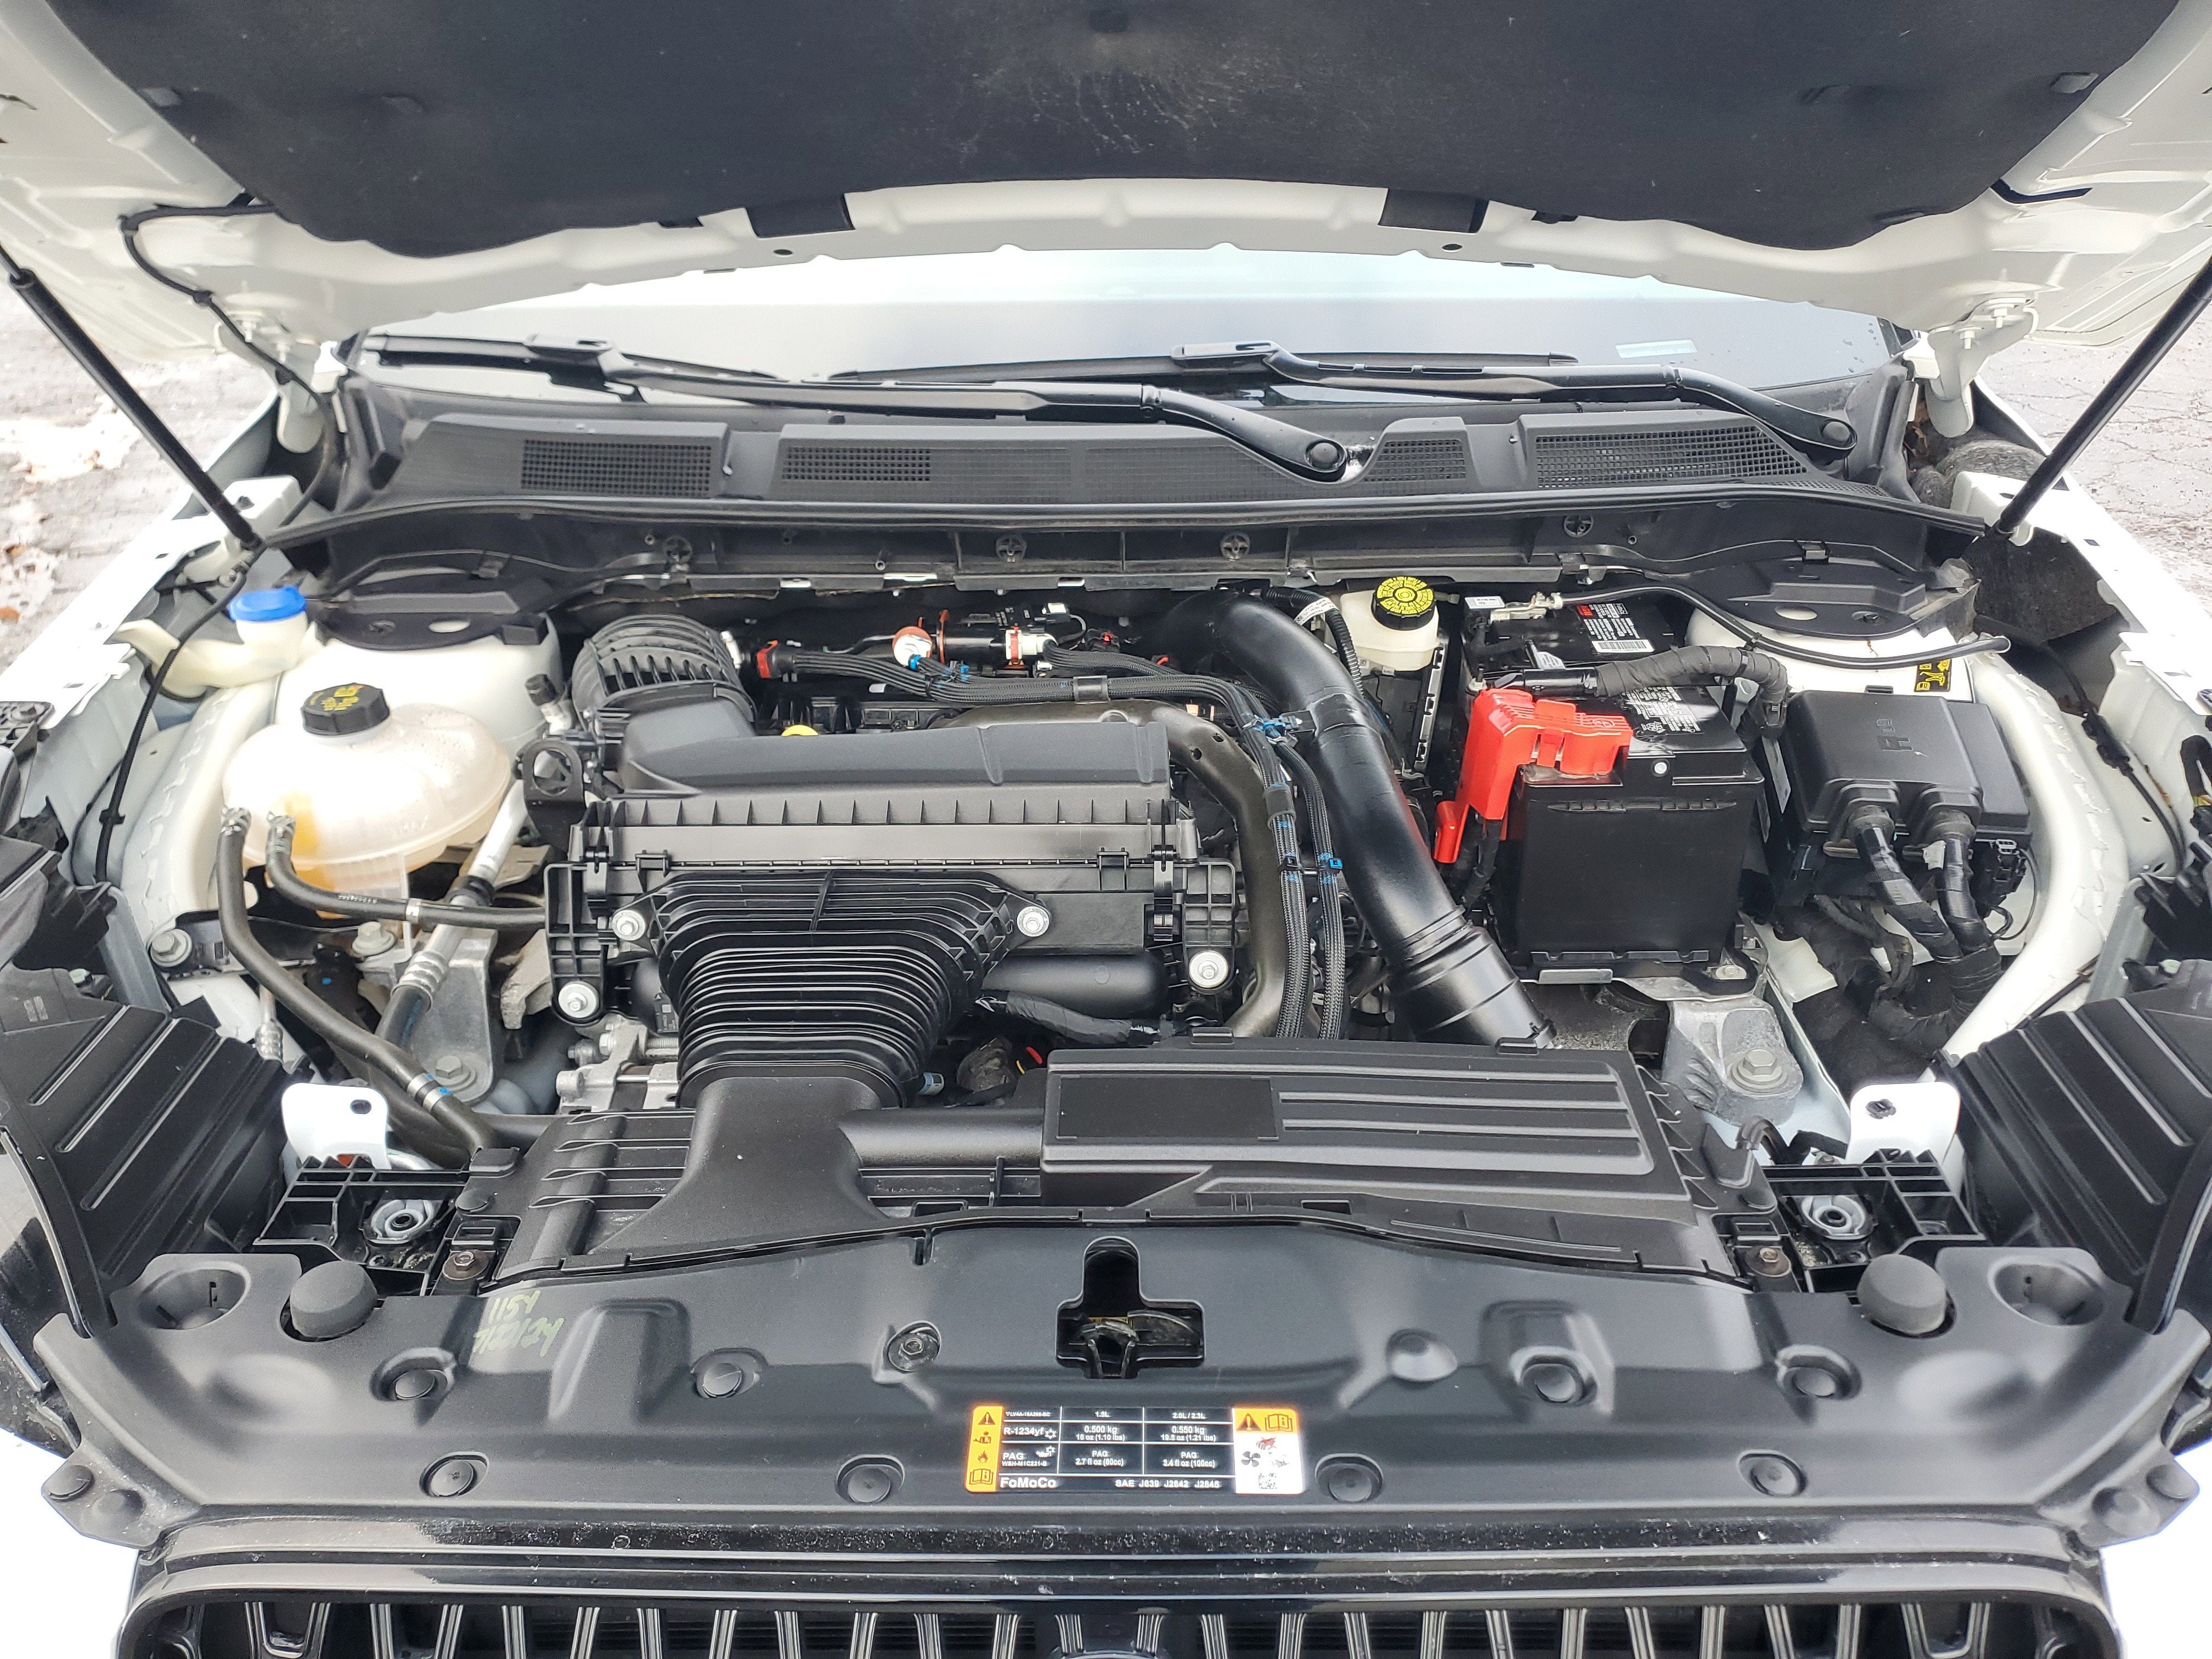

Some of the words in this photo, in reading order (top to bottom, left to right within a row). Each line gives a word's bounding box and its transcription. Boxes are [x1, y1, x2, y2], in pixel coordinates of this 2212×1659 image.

[1003, 1427, 1044, 1436] R-1234yf
[1107, 1425, 1118, 1435] kg
[1195, 1425, 1205, 1435] kg
[1113, 1434, 1125, 1442] lbs)
[1190, 1459, 1216, 1469] (100cc)
[1000, 1477, 1057, 1488] FoMoCo
